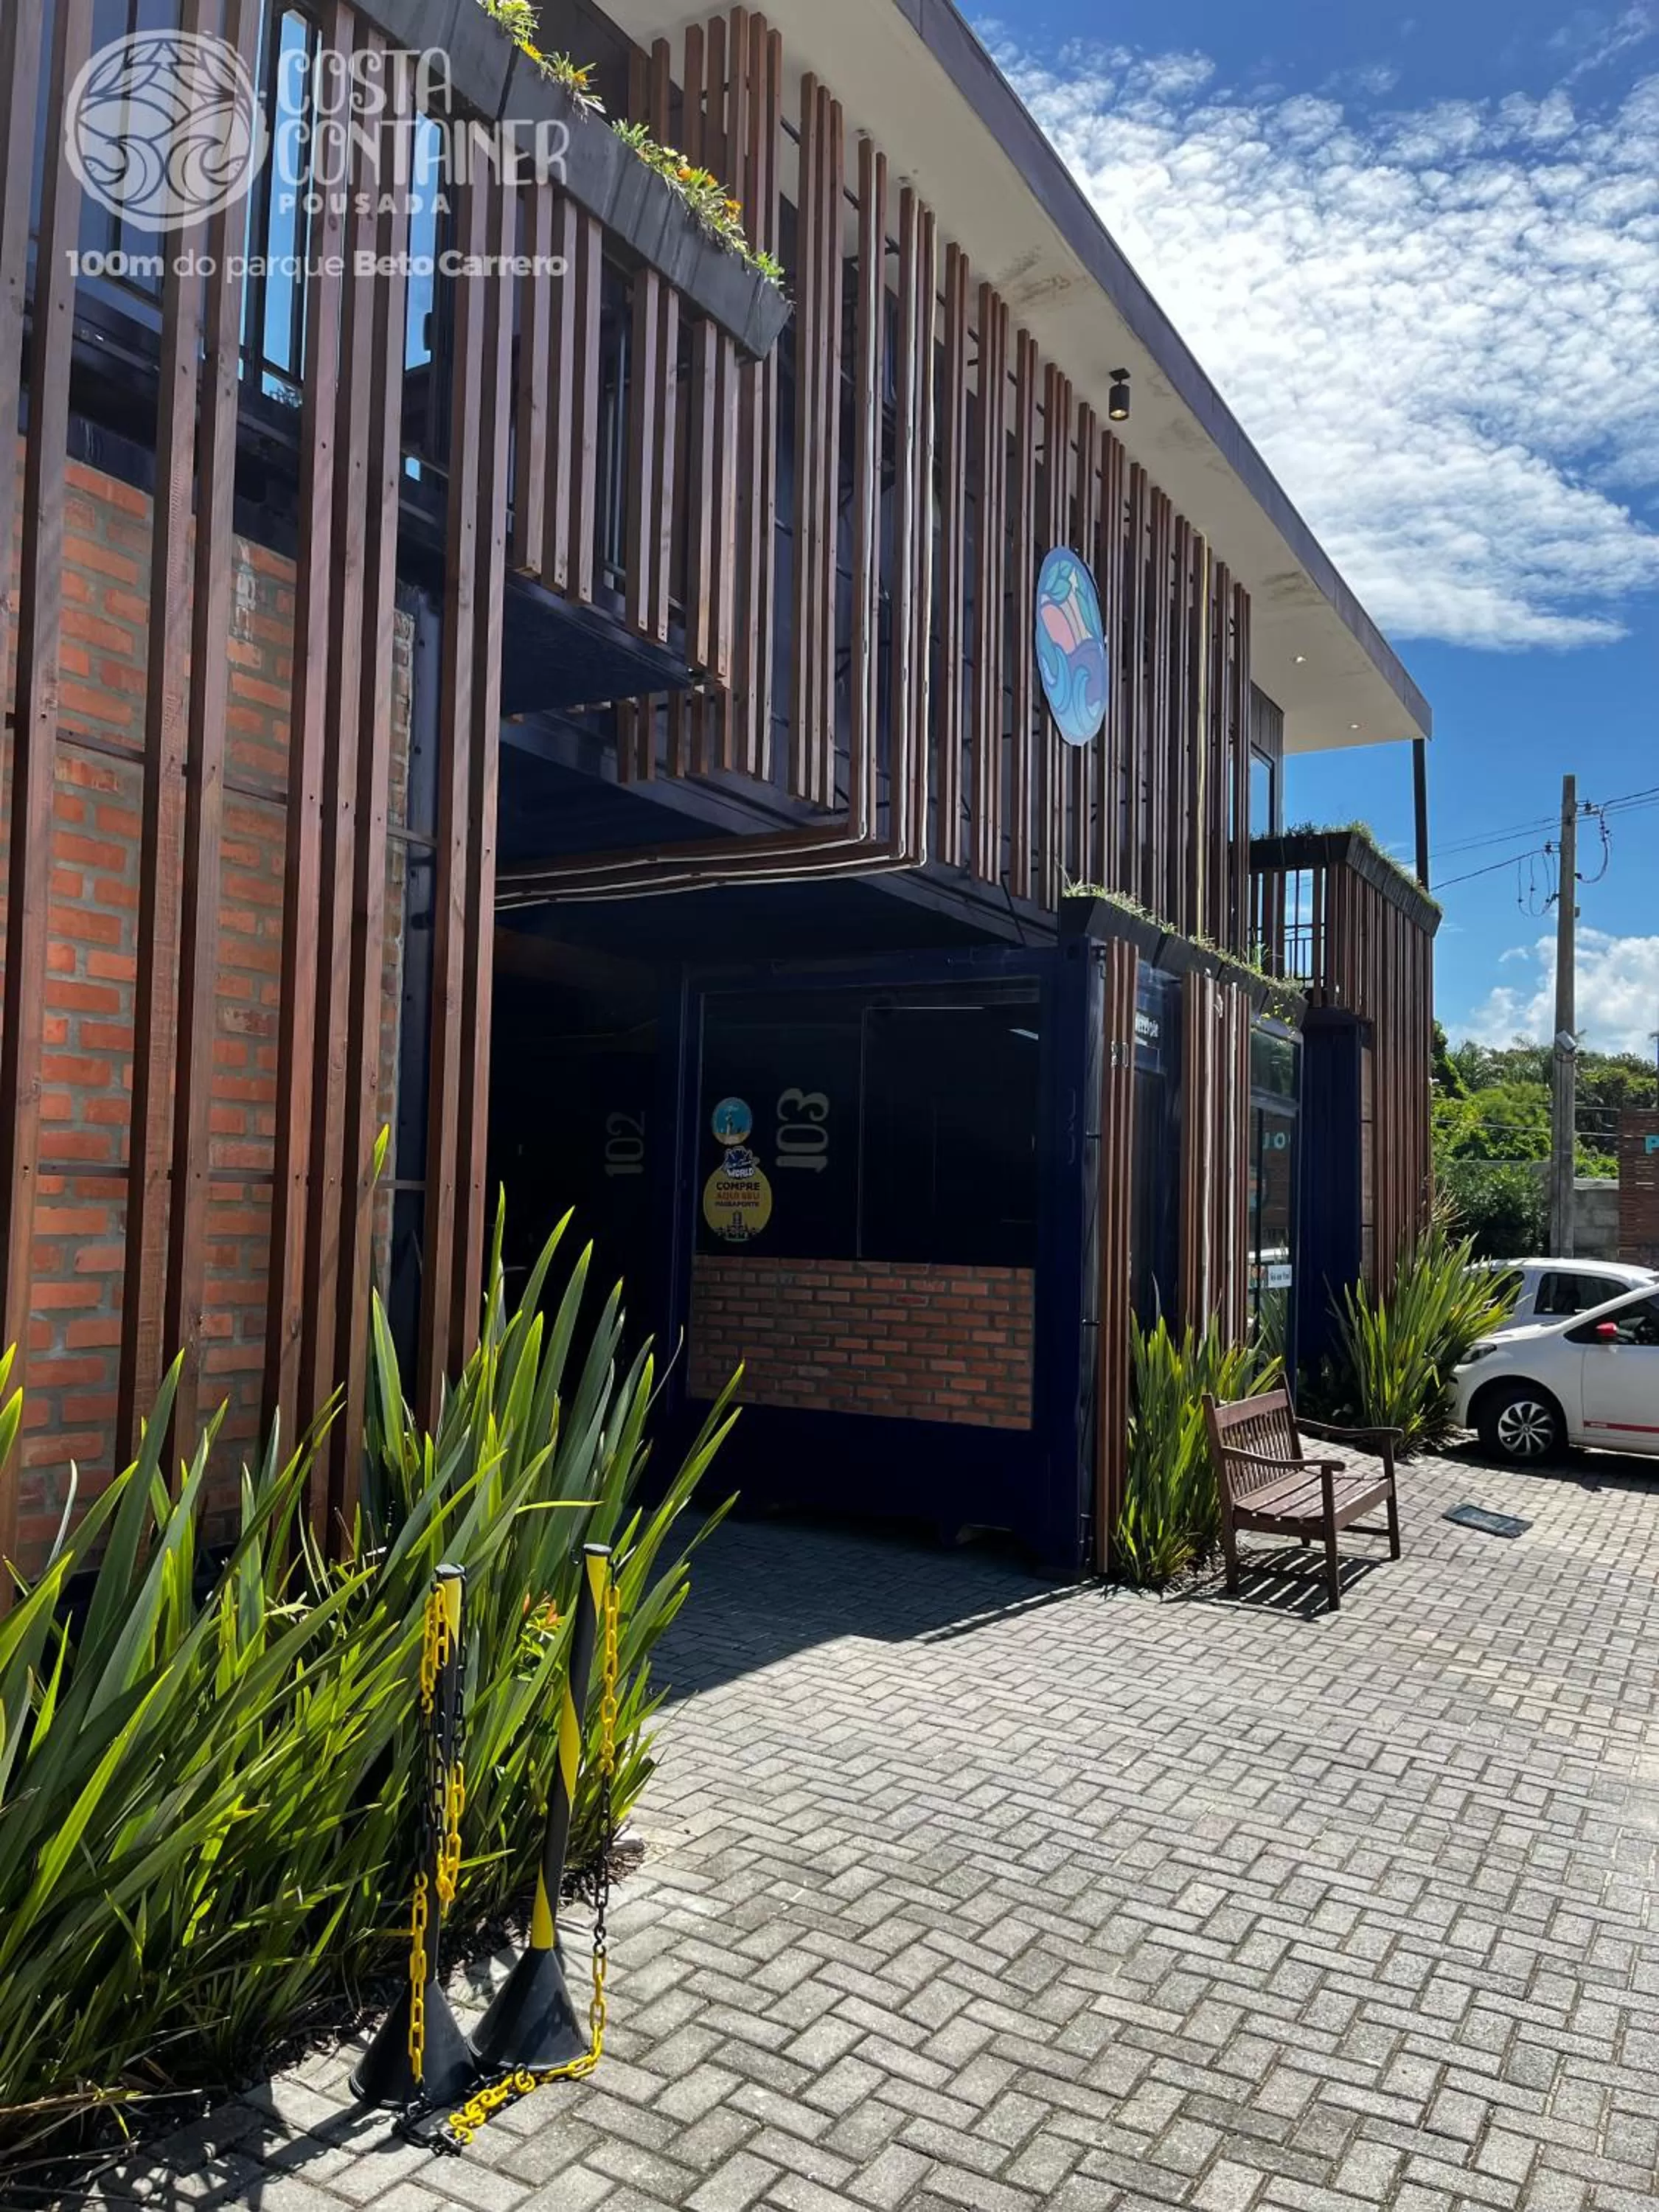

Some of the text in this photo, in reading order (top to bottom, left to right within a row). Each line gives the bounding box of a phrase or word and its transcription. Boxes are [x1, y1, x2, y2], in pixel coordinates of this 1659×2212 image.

[605, 1111, 644, 1177] 102
[776, 1088, 830, 1173] 103
[716, 1182, 760, 1191] COMPRE
[726, 1166, 755, 1178] WORLD
